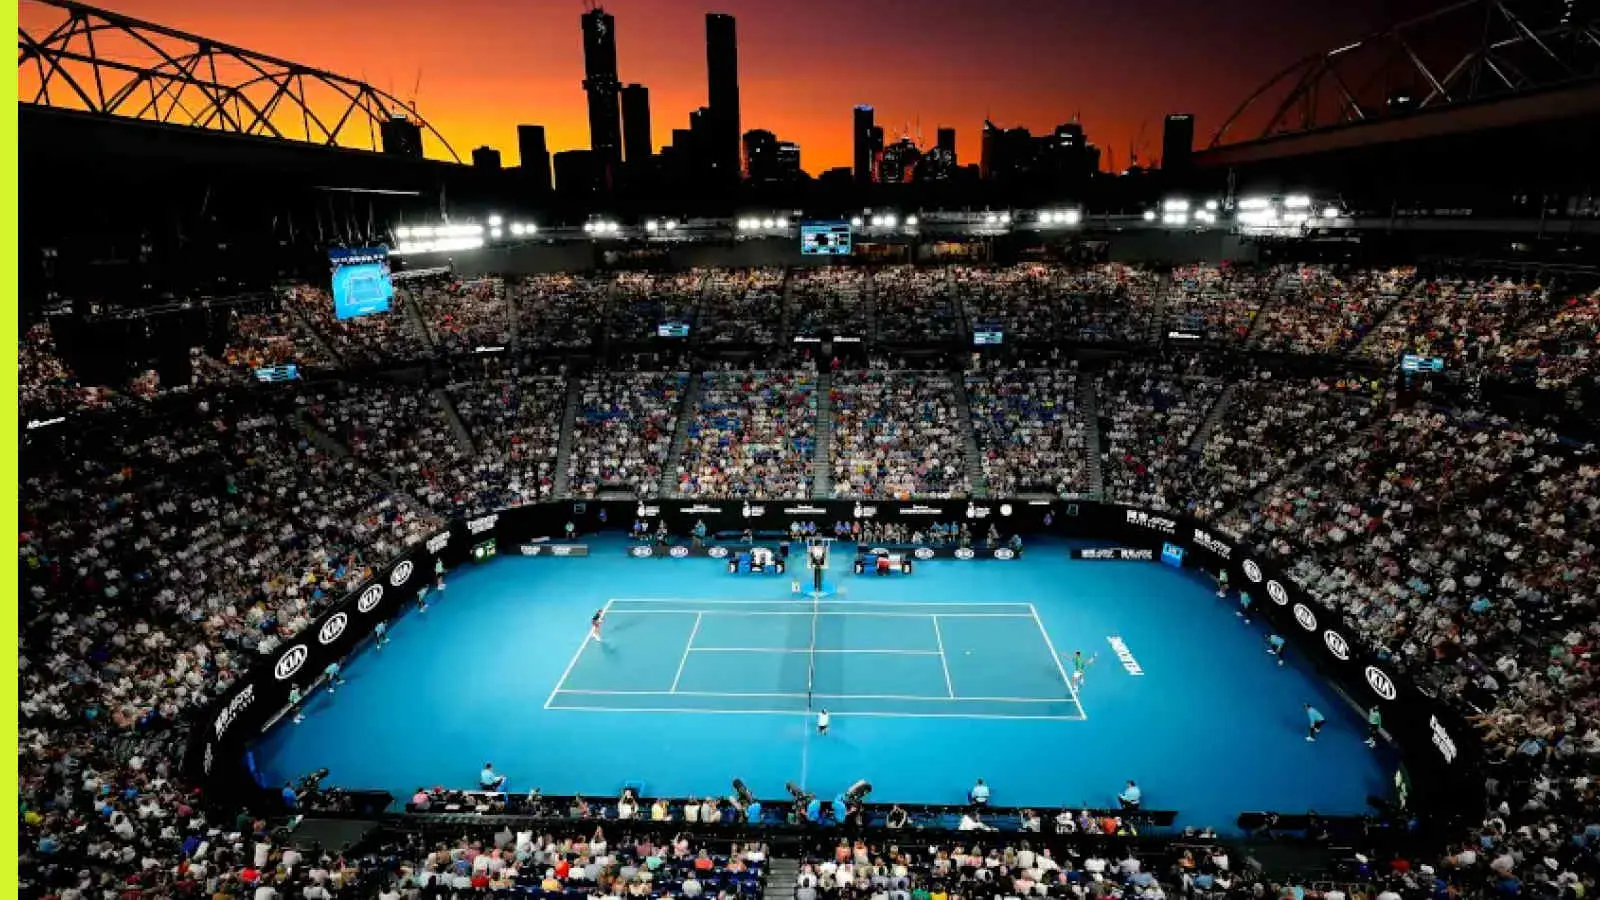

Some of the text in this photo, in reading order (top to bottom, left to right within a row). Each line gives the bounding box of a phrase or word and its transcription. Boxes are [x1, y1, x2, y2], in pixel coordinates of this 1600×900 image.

[359, 586, 382, 611] KIA
[320, 614, 346, 642] KIA
[277, 647, 306, 678] KIA
[1367, 668, 1394, 698] KIA
